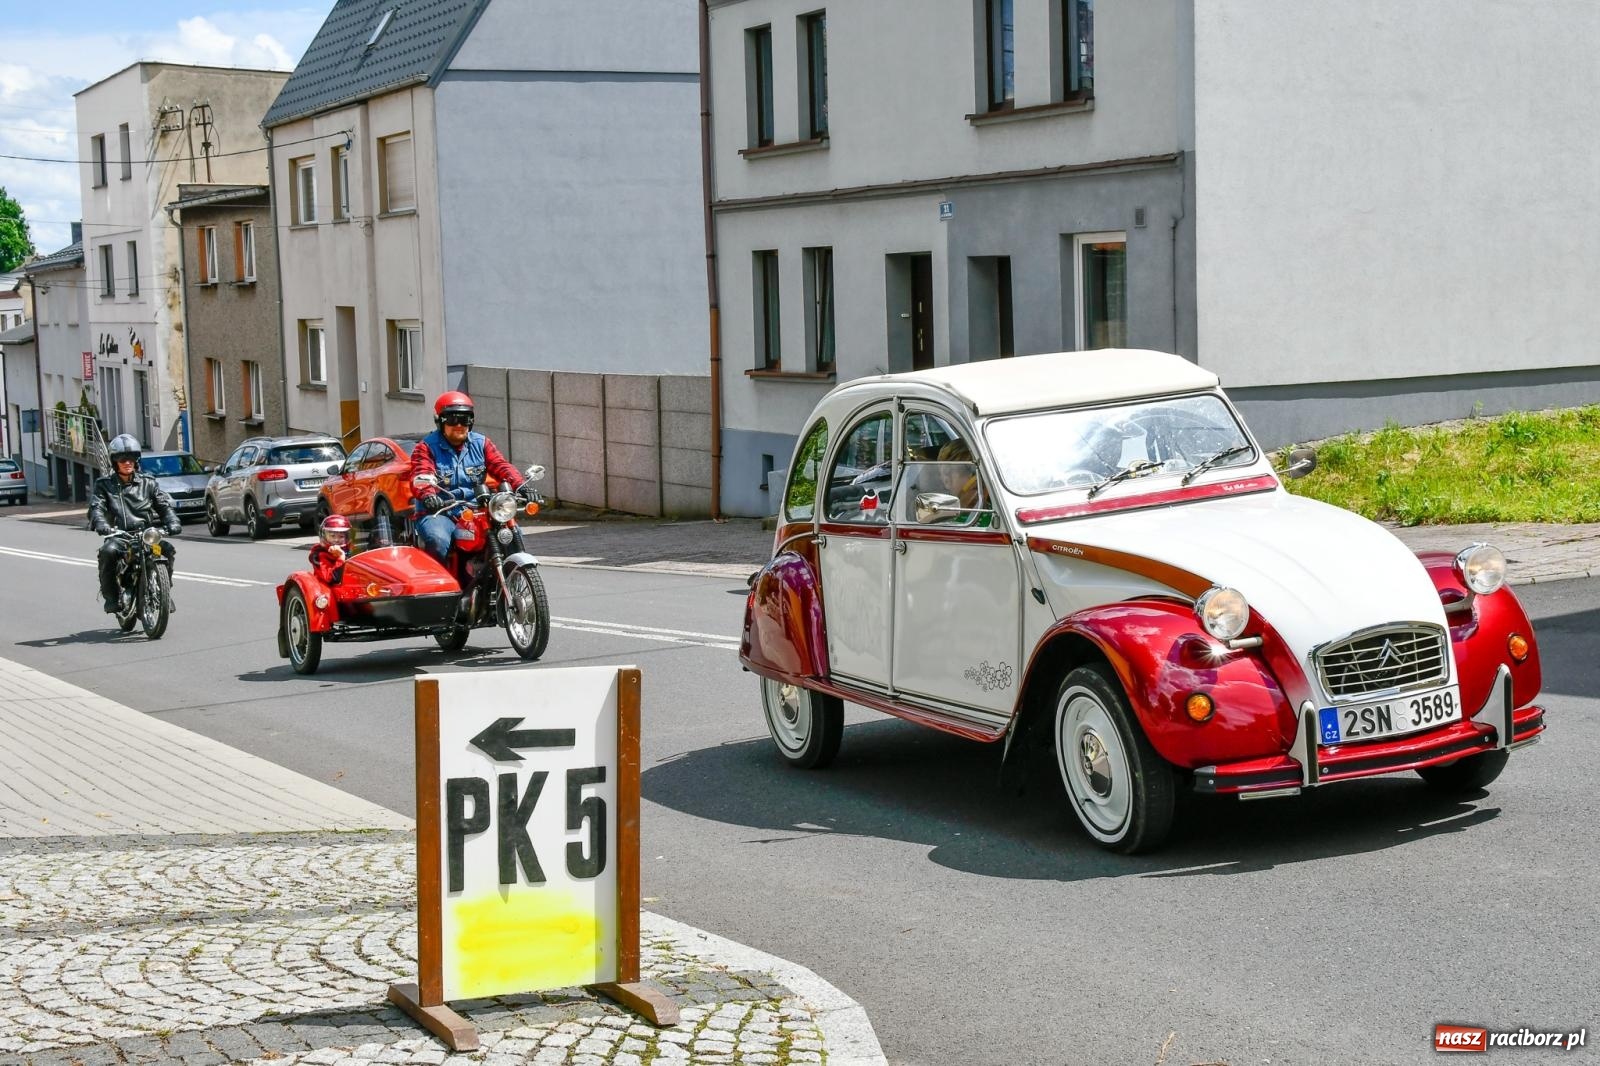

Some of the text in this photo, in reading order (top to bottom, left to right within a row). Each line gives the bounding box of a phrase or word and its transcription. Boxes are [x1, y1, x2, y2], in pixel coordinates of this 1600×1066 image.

[1052, 544, 1084, 556] CITROËN
[1344, 691, 1454, 737] 2SN 3589
[1325, 730, 1338, 740] CZ
[446, 765, 607, 892] PK 5
